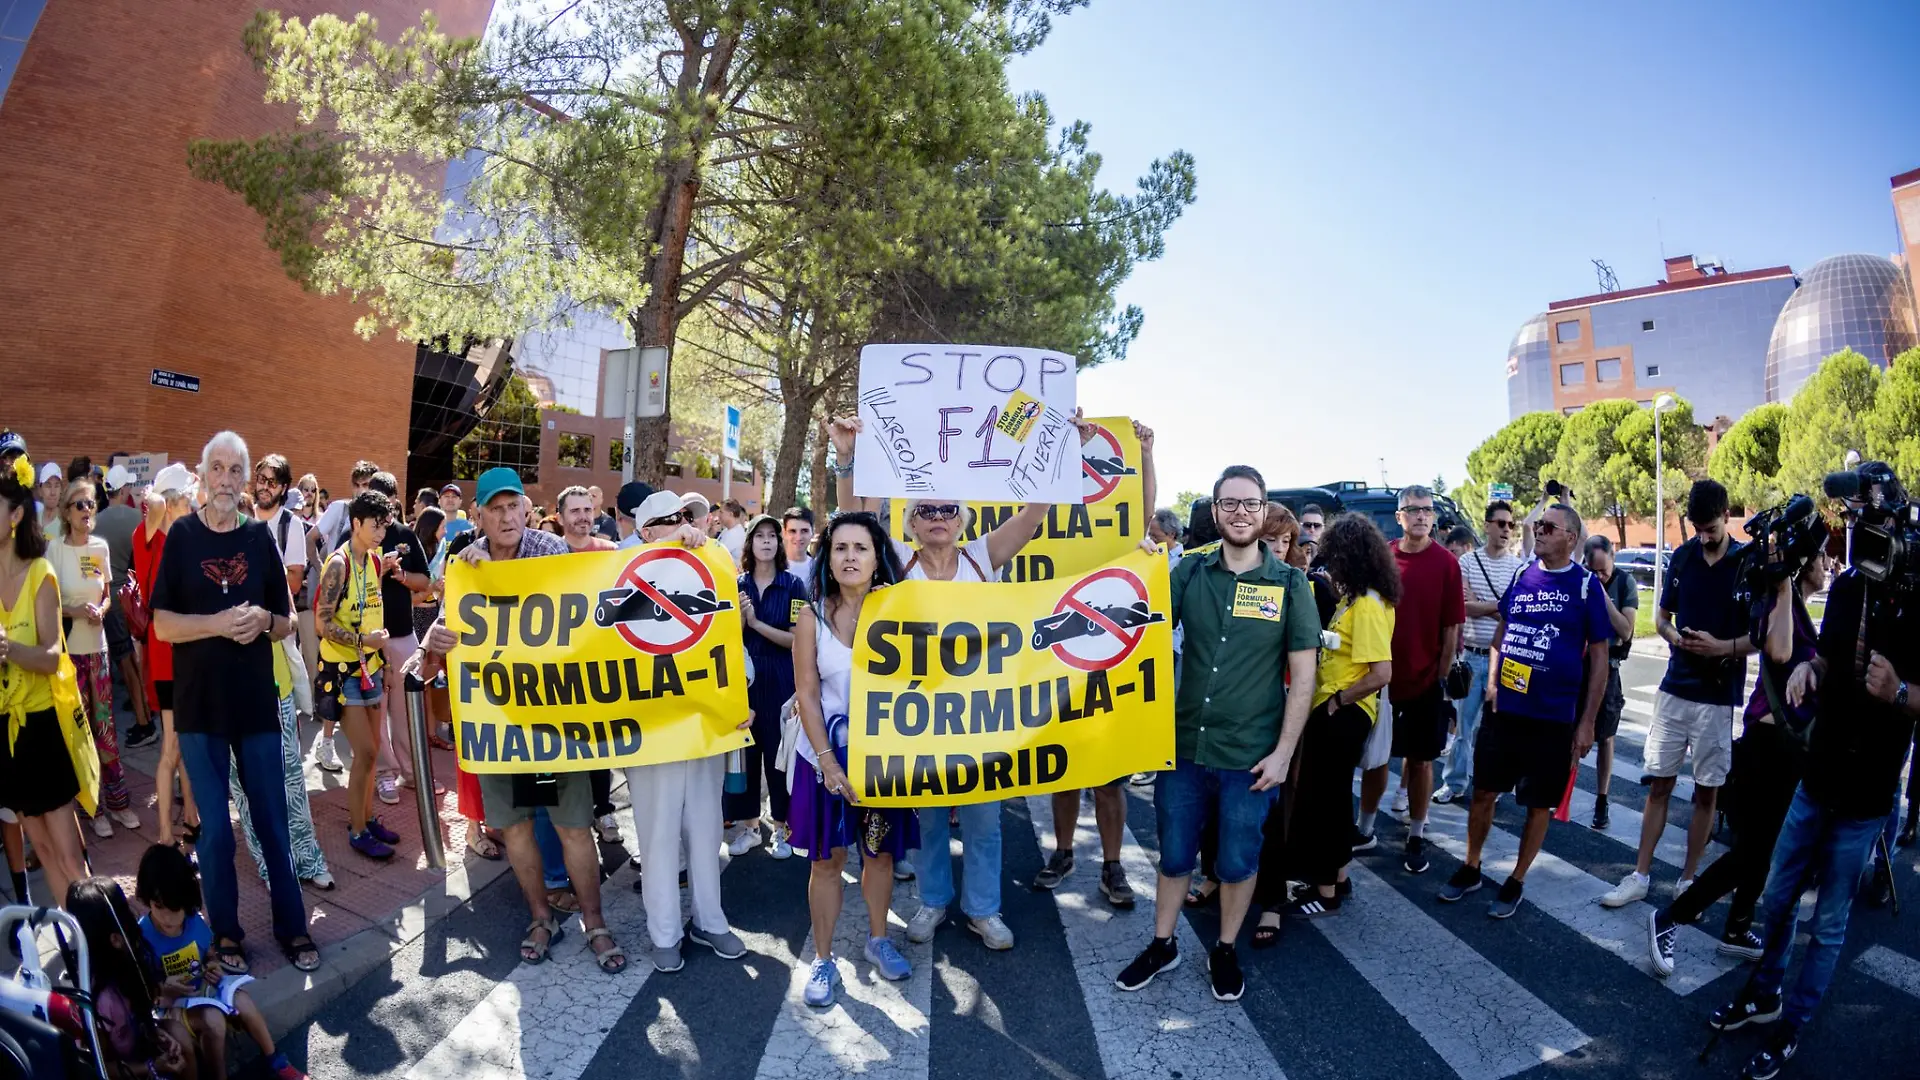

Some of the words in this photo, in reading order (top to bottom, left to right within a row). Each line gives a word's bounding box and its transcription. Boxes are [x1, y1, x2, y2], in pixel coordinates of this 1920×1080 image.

[895, 352, 1067, 396] STOP
[938, 405, 1012, 468] F1
[996, 411, 1010, 430] STOP
[1010, 414, 1026, 437] MADRID
[1238, 586, 1258, 594] STOP
[1510, 602, 1522, 614] de
[1525, 601, 1563, 613] macho
[1537, 589, 1570, 602] tacho
[458, 593, 588, 647] STOP
[866, 620, 1024, 677] STOP
[1507, 645, 1545, 661] MACHISMO
[460, 645, 729, 707] FÓRMULA-1
[866, 658, 1156, 736] FÓRMULA-1
[461, 718, 642, 762] MADRID
[865, 743, 1068, 798] MADRID
[164, 953, 180, 964] STOP
